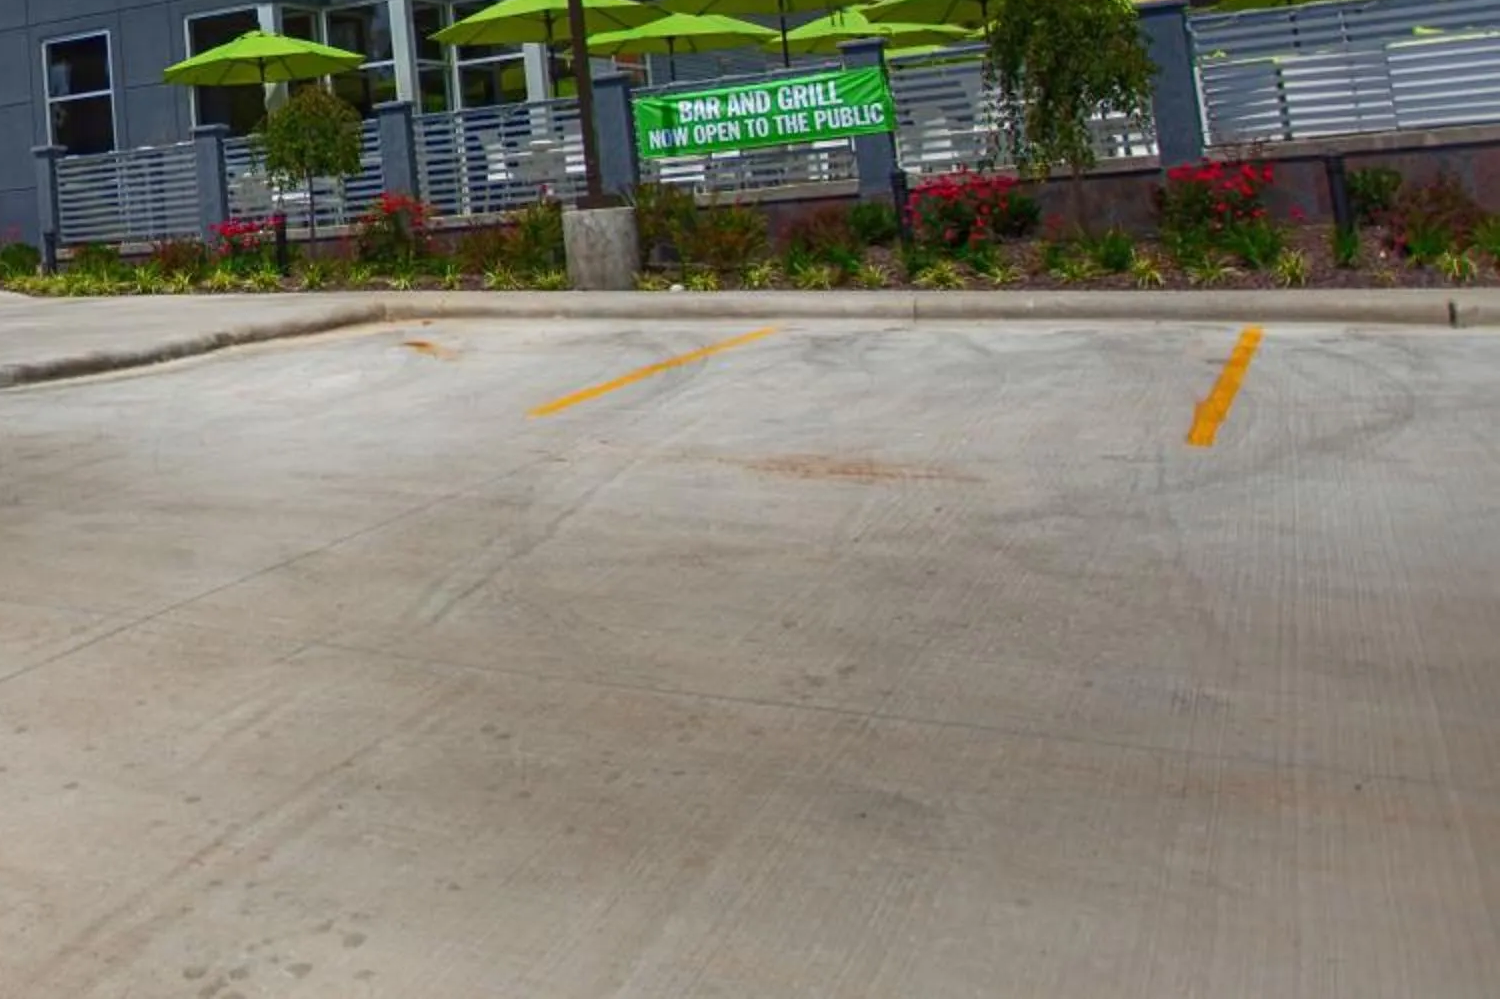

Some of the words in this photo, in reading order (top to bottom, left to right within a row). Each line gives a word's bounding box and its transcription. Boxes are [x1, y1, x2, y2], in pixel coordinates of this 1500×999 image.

[678, 98, 721, 123] BAR
[727, 90, 771, 116] AND
[777, 80, 844, 110] GRILL
[649, 127, 688, 150] NOW
[693, 120, 740, 144] OPEN
[746, 116, 769, 137] TO
[772, 113, 810, 134] THE
[814, 102, 885, 129] PUBLIC
